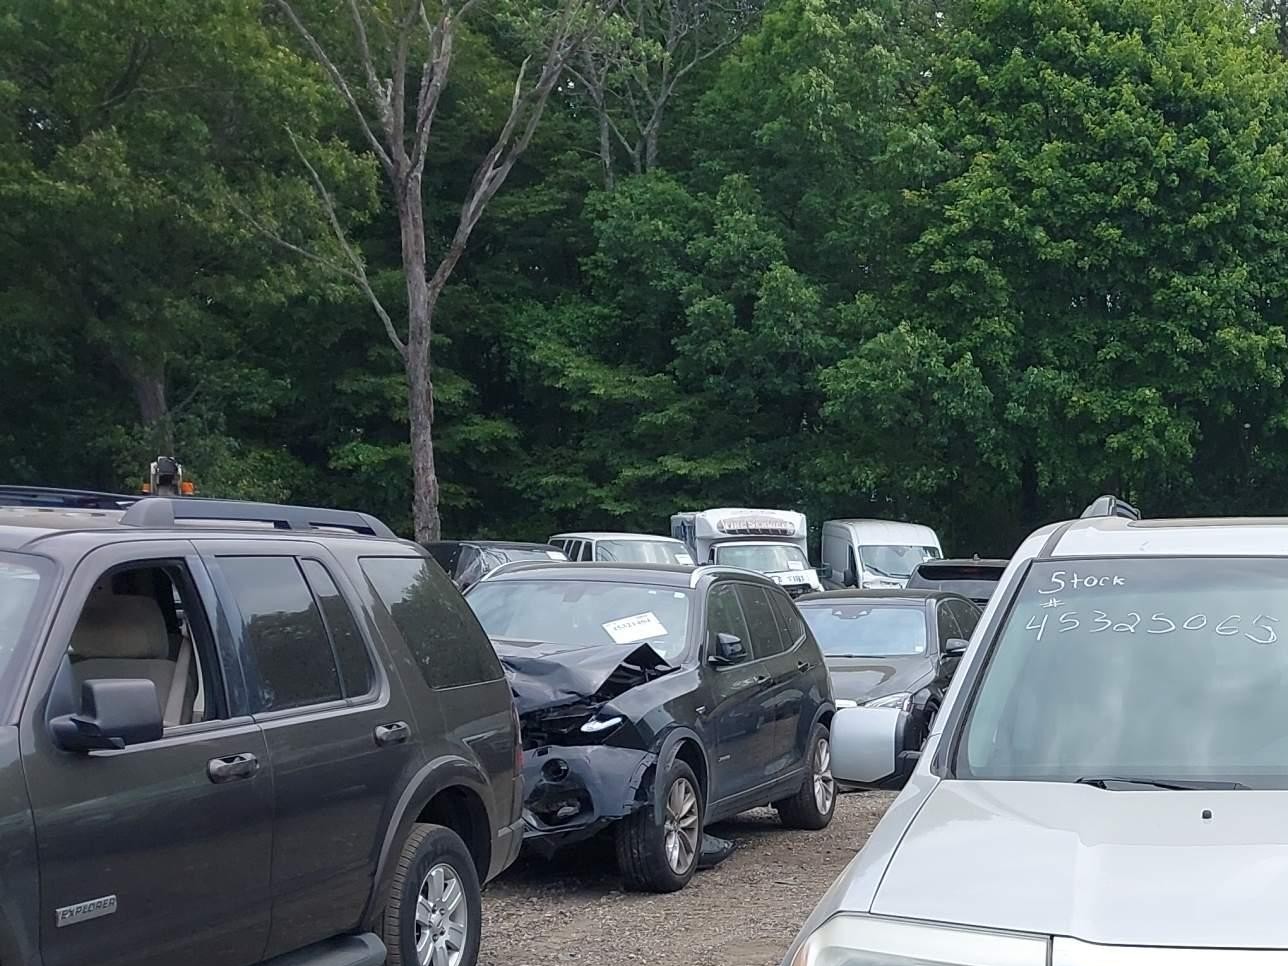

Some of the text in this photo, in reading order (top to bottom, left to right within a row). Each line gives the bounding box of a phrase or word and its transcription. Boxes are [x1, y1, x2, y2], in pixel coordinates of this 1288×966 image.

[1038, 571, 1126, 594] Stock
[1025, 609, 1280, 644] 45325065
[59, 897, 115, 920] EXPLORER
